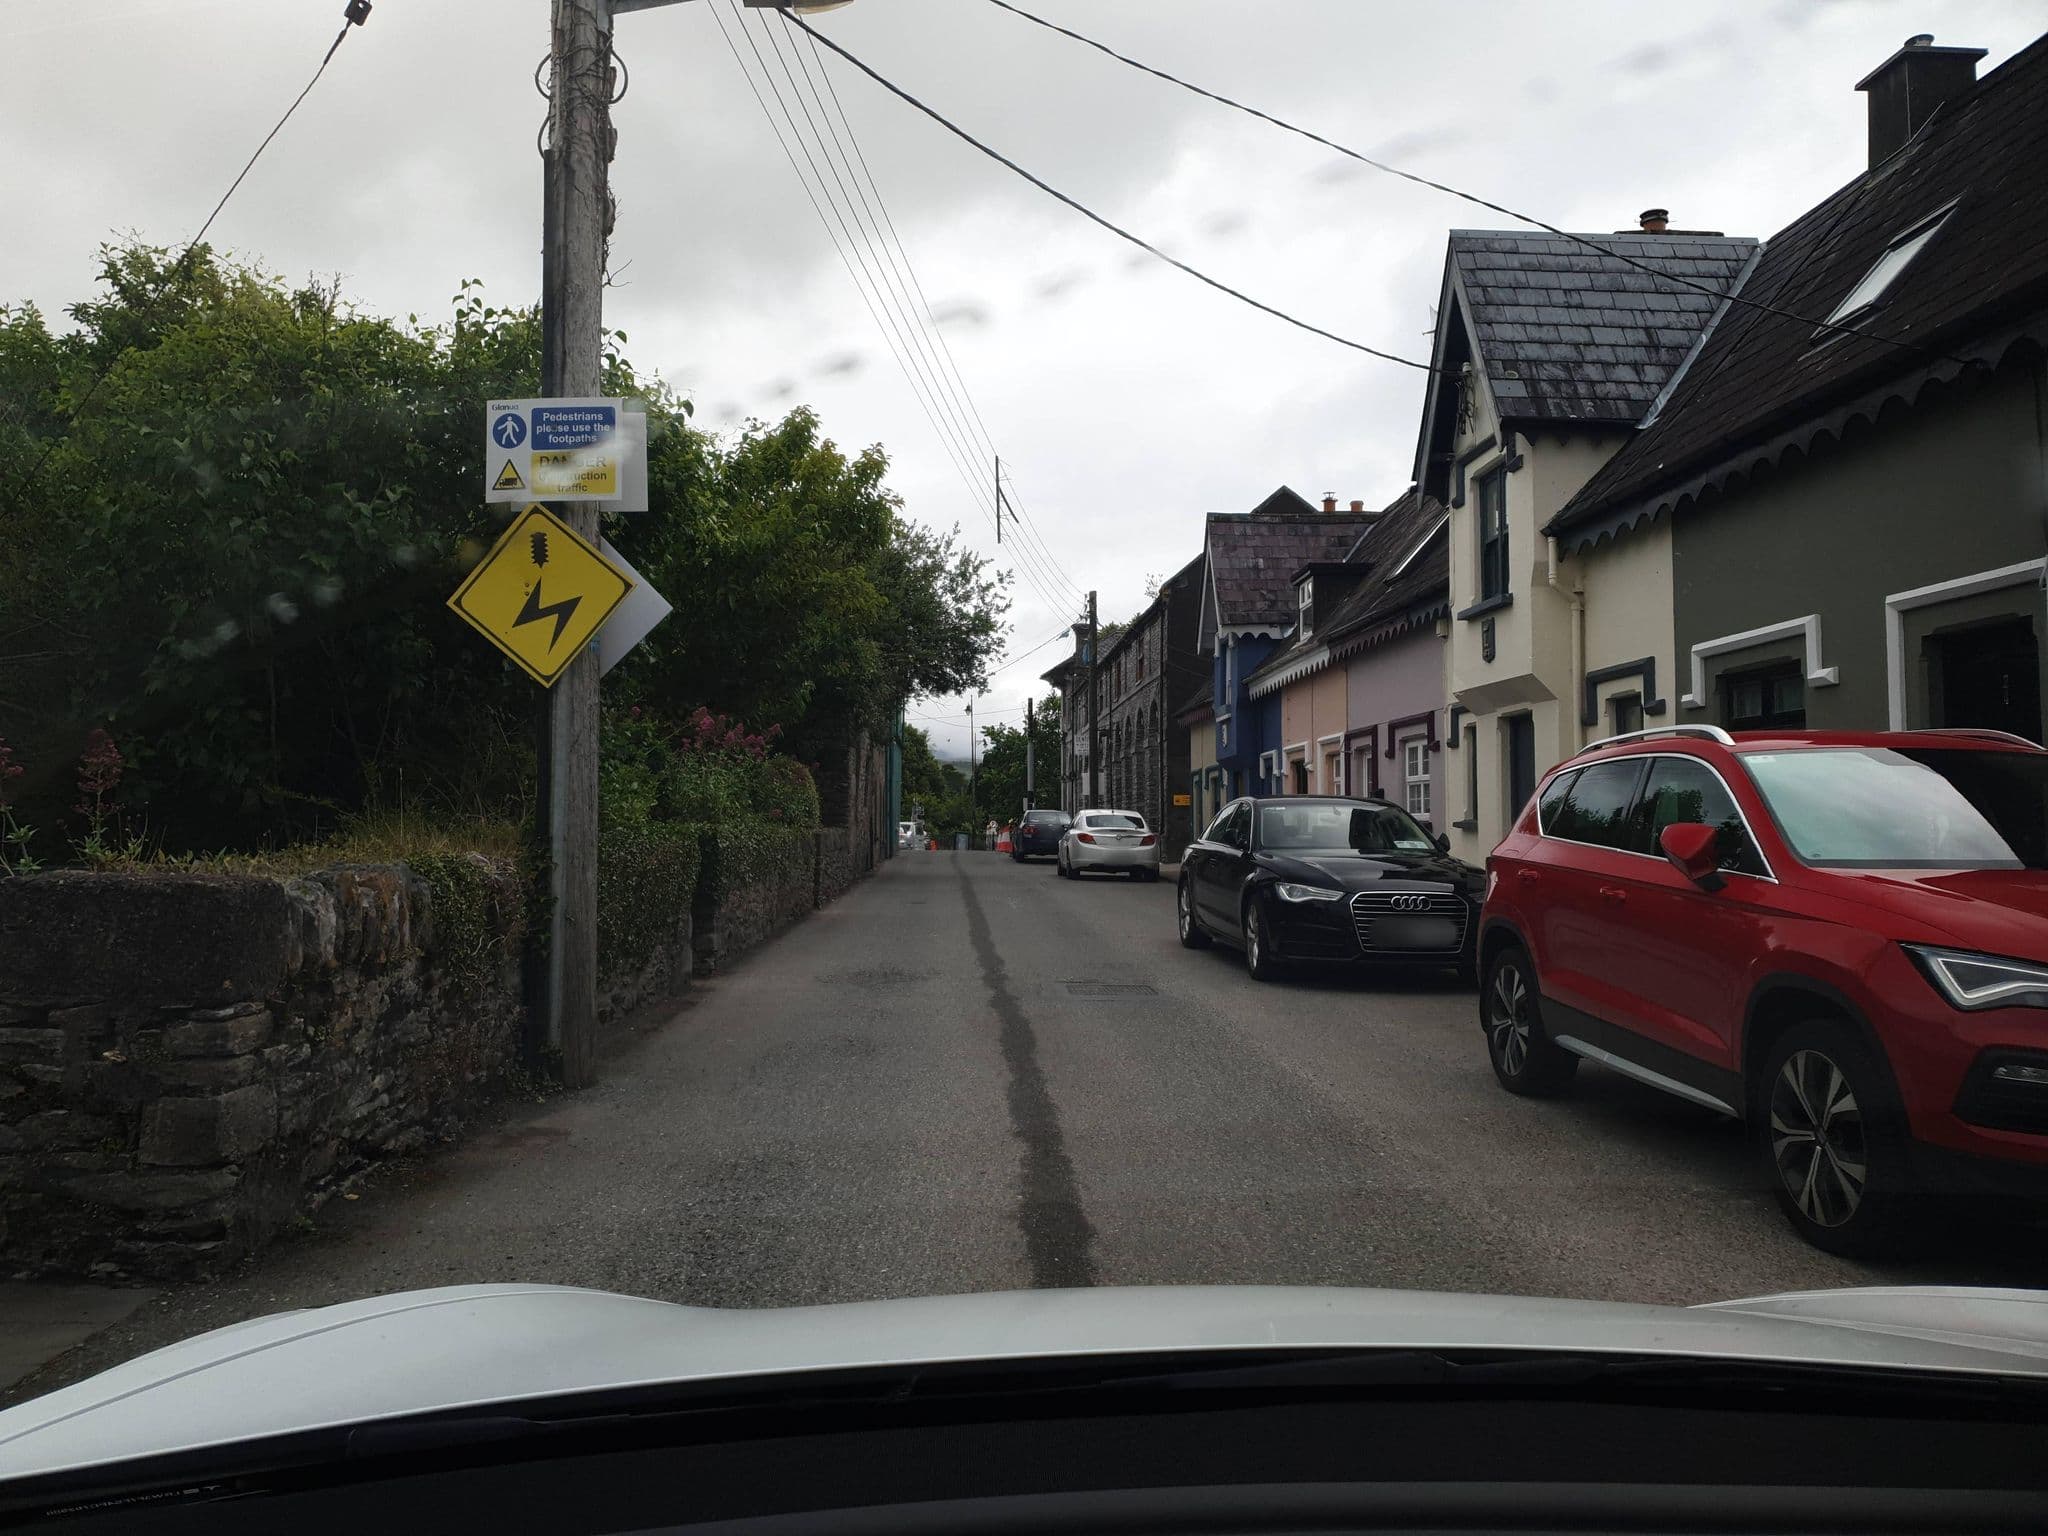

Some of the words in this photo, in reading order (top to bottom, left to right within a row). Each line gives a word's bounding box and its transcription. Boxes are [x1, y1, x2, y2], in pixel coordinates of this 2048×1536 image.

[543, 412, 603, 422] Pedestrians
[536, 423, 569, 435] plese
[593, 423, 610, 432] the
[548, 434, 597, 444] footpaths
[539, 471, 607, 481] Cuction
[558, 482, 588, 492] traffic
